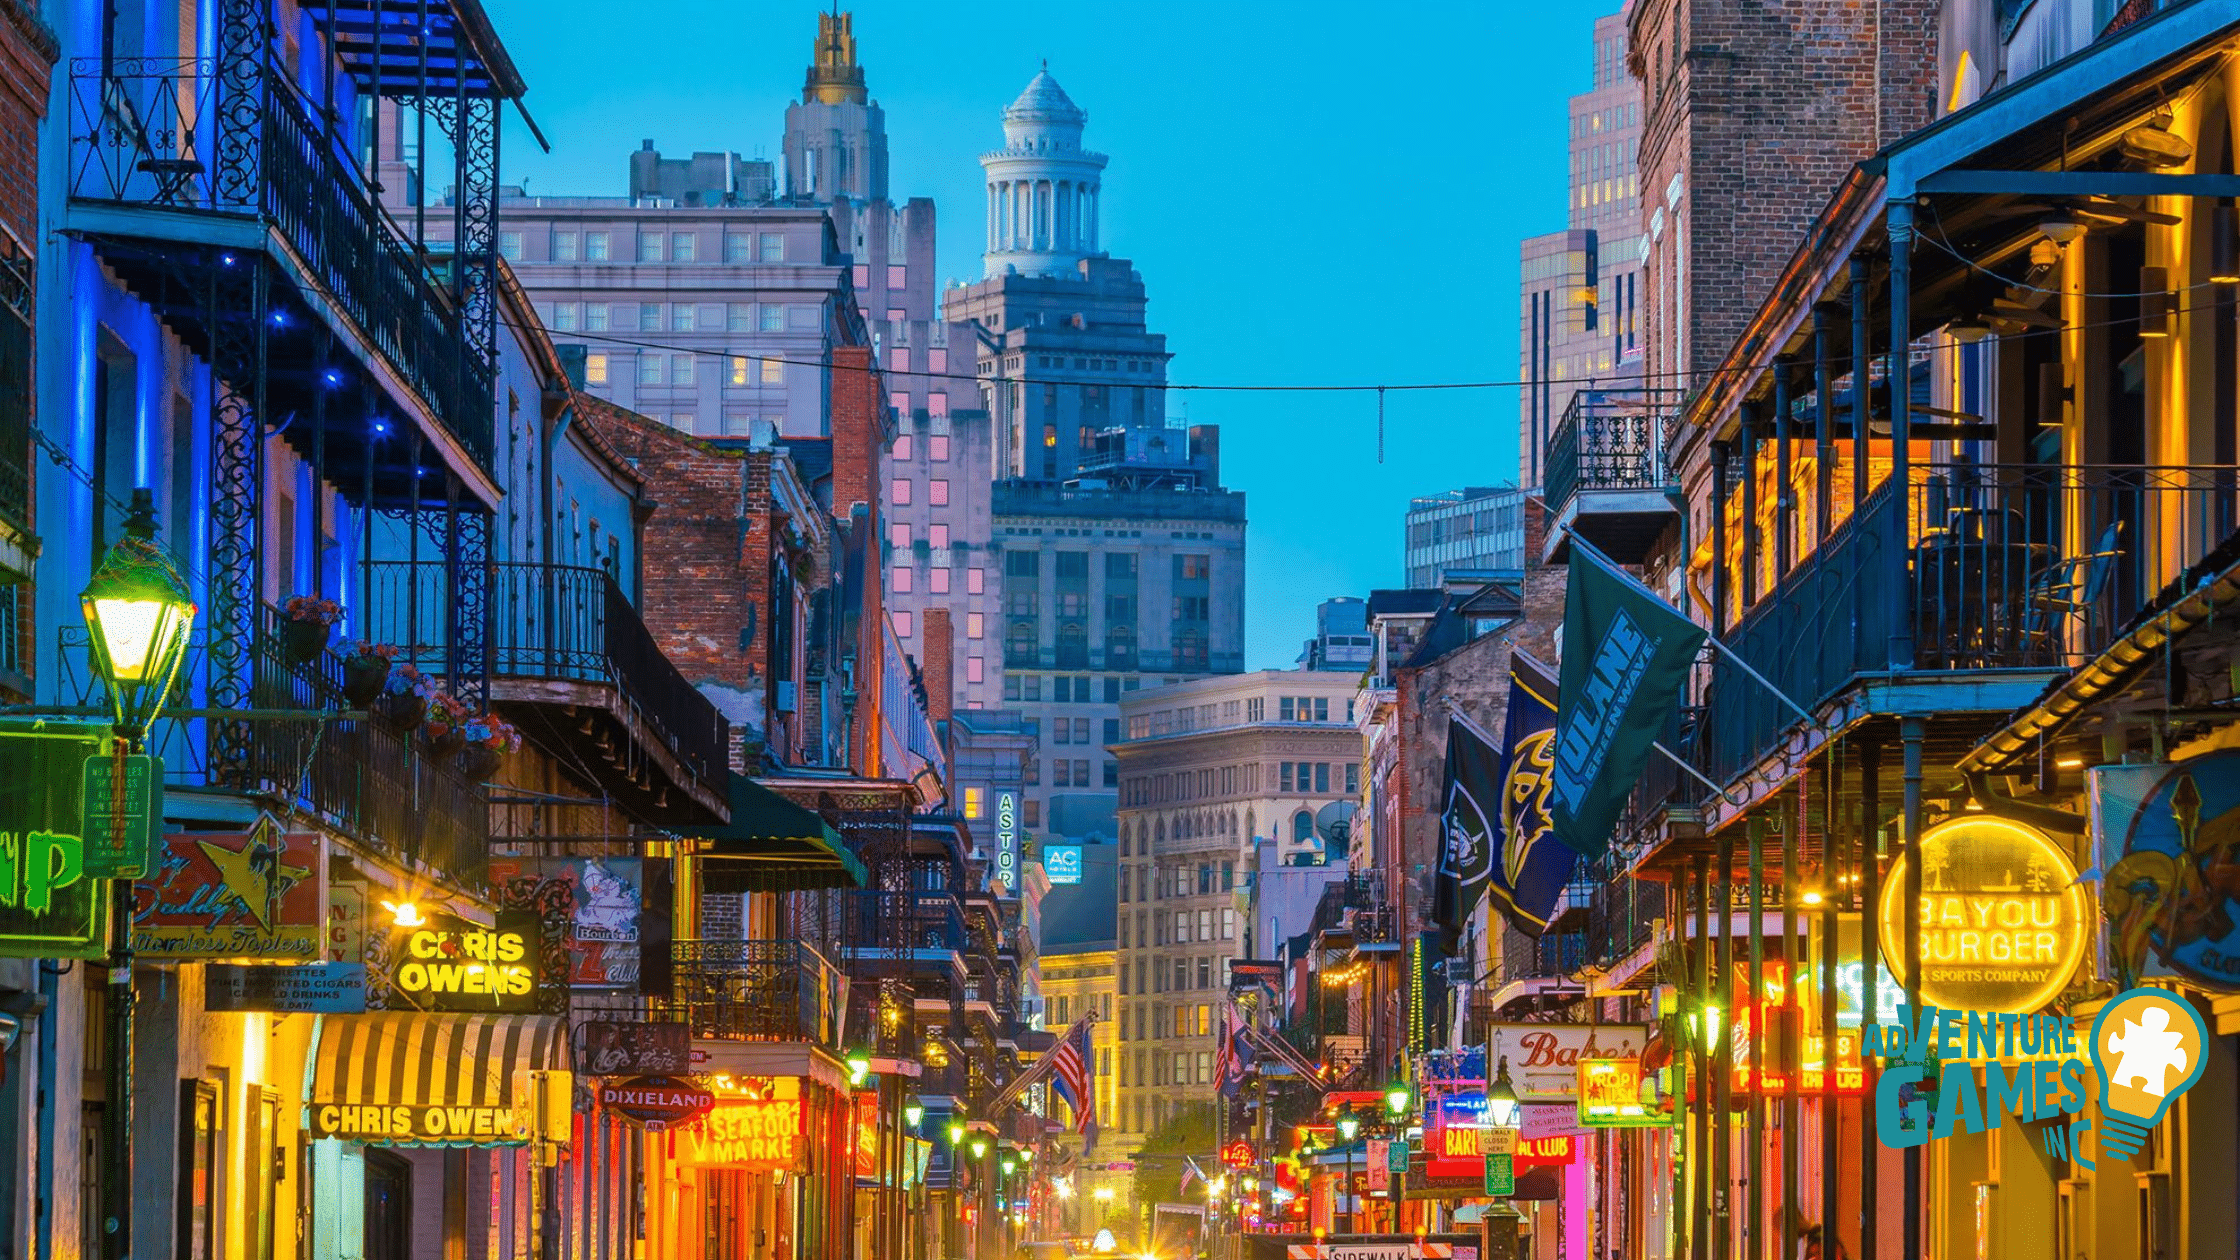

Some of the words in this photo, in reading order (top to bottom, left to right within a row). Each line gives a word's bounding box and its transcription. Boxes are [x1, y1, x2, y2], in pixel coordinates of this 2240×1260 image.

[998, 793, 1014, 888] ASTOR
[1049, 850, 1077, 866] AC
[1920, 896, 2057, 929] BAYOU
[1920, 930, 2057, 962] BURGER
[314, 979, 362, 989] CIGARS
[1932, 970, 1982, 983] SPORTS
[1984, 969, 2050, 983] COMPANY
[291, 990, 341, 1000] DRINKS
[603, 1088, 712, 1109] DIXIELAND
[319, 1104, 413, 1134] CHRIS
[424, 1107, 513, 1136] OWEN
[713, 1135, 792, 1163] MARKE
[1536, 1136, 1569, 1157] CLUB
